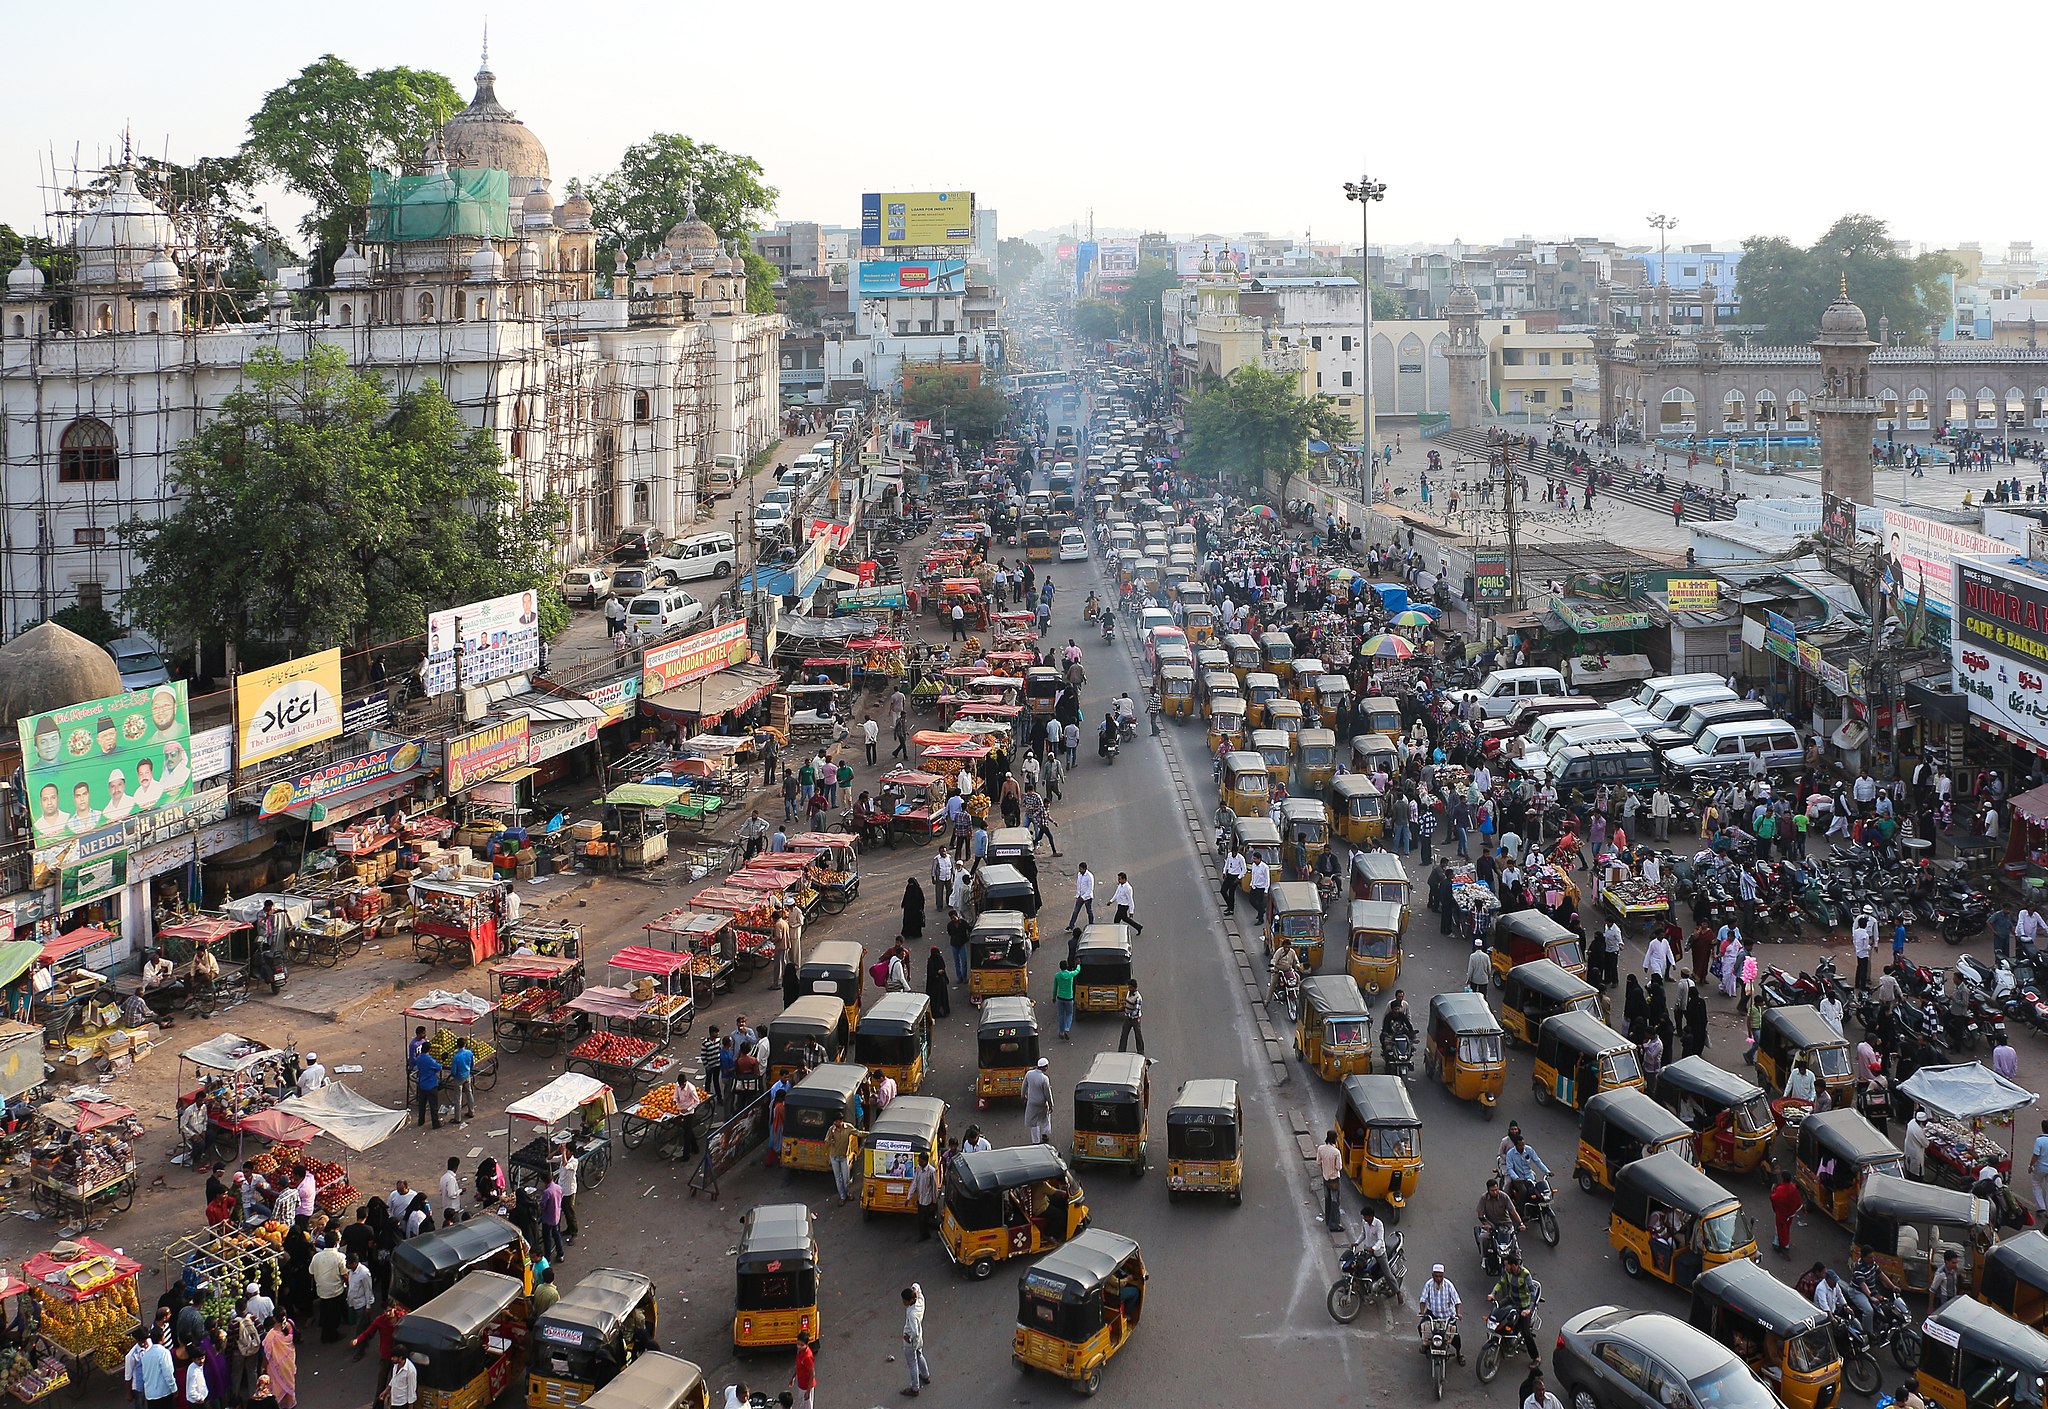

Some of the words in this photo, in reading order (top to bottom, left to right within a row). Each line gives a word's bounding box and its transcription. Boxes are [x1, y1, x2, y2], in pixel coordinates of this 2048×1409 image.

[1884, 509, 1927, 535] PRESIDENCY
[1928, 521, 1953, 543] JUNIOR
[1953, 531, 1960, 545] &
[1960, 533, 1988, 554] DEGREE
[1907, 542, 1932, 559] Separate
[1478, 576, 1505, 588] PEARLS
[1981, 574, 1993, 585] 1993
[1967, 616, 1994, 639] CAFE
[1996, 627, 2005, 643] &
[2006, 631, 2048, 661] BAKERY
[665, 656, 705, 679] MUQADDAR
[705, 644, 727, 667] HOTEL
[262, 688, 317, 733] اعتماد
[598, 692, 622, 706] SHOP
[54, 711, 70, 725] Eid
[70, 703, 104, 722] Mubarak
[250, 738, 263, 749] The
[265, 728, 297, 745] Etemaad
[297, 721, 315, 735] Urdu
[316, 714, 333, 729] Daily
[451, 739, 468, 761] ABUL
[469, 726, 502, 753] BARKAAT
[502, 716, 529, 740] BAKERY
[531, 730, 556, 747] ROSHAN
[557, 722, 578, 737] SWEET
[299, 752, 387, 788] SADDAM
[471, 762, 482, 771] COOL
[294, 778, 342, 799] KAANI
[345, 762, 389, 782] BIRYANI
[81, 831, 123, 858] NEEDS
[998, 1029, 1005, 1037] S
[1009, 1029, 1016, 1037] S
[1758, 1318, 1774, 1331] 2013
